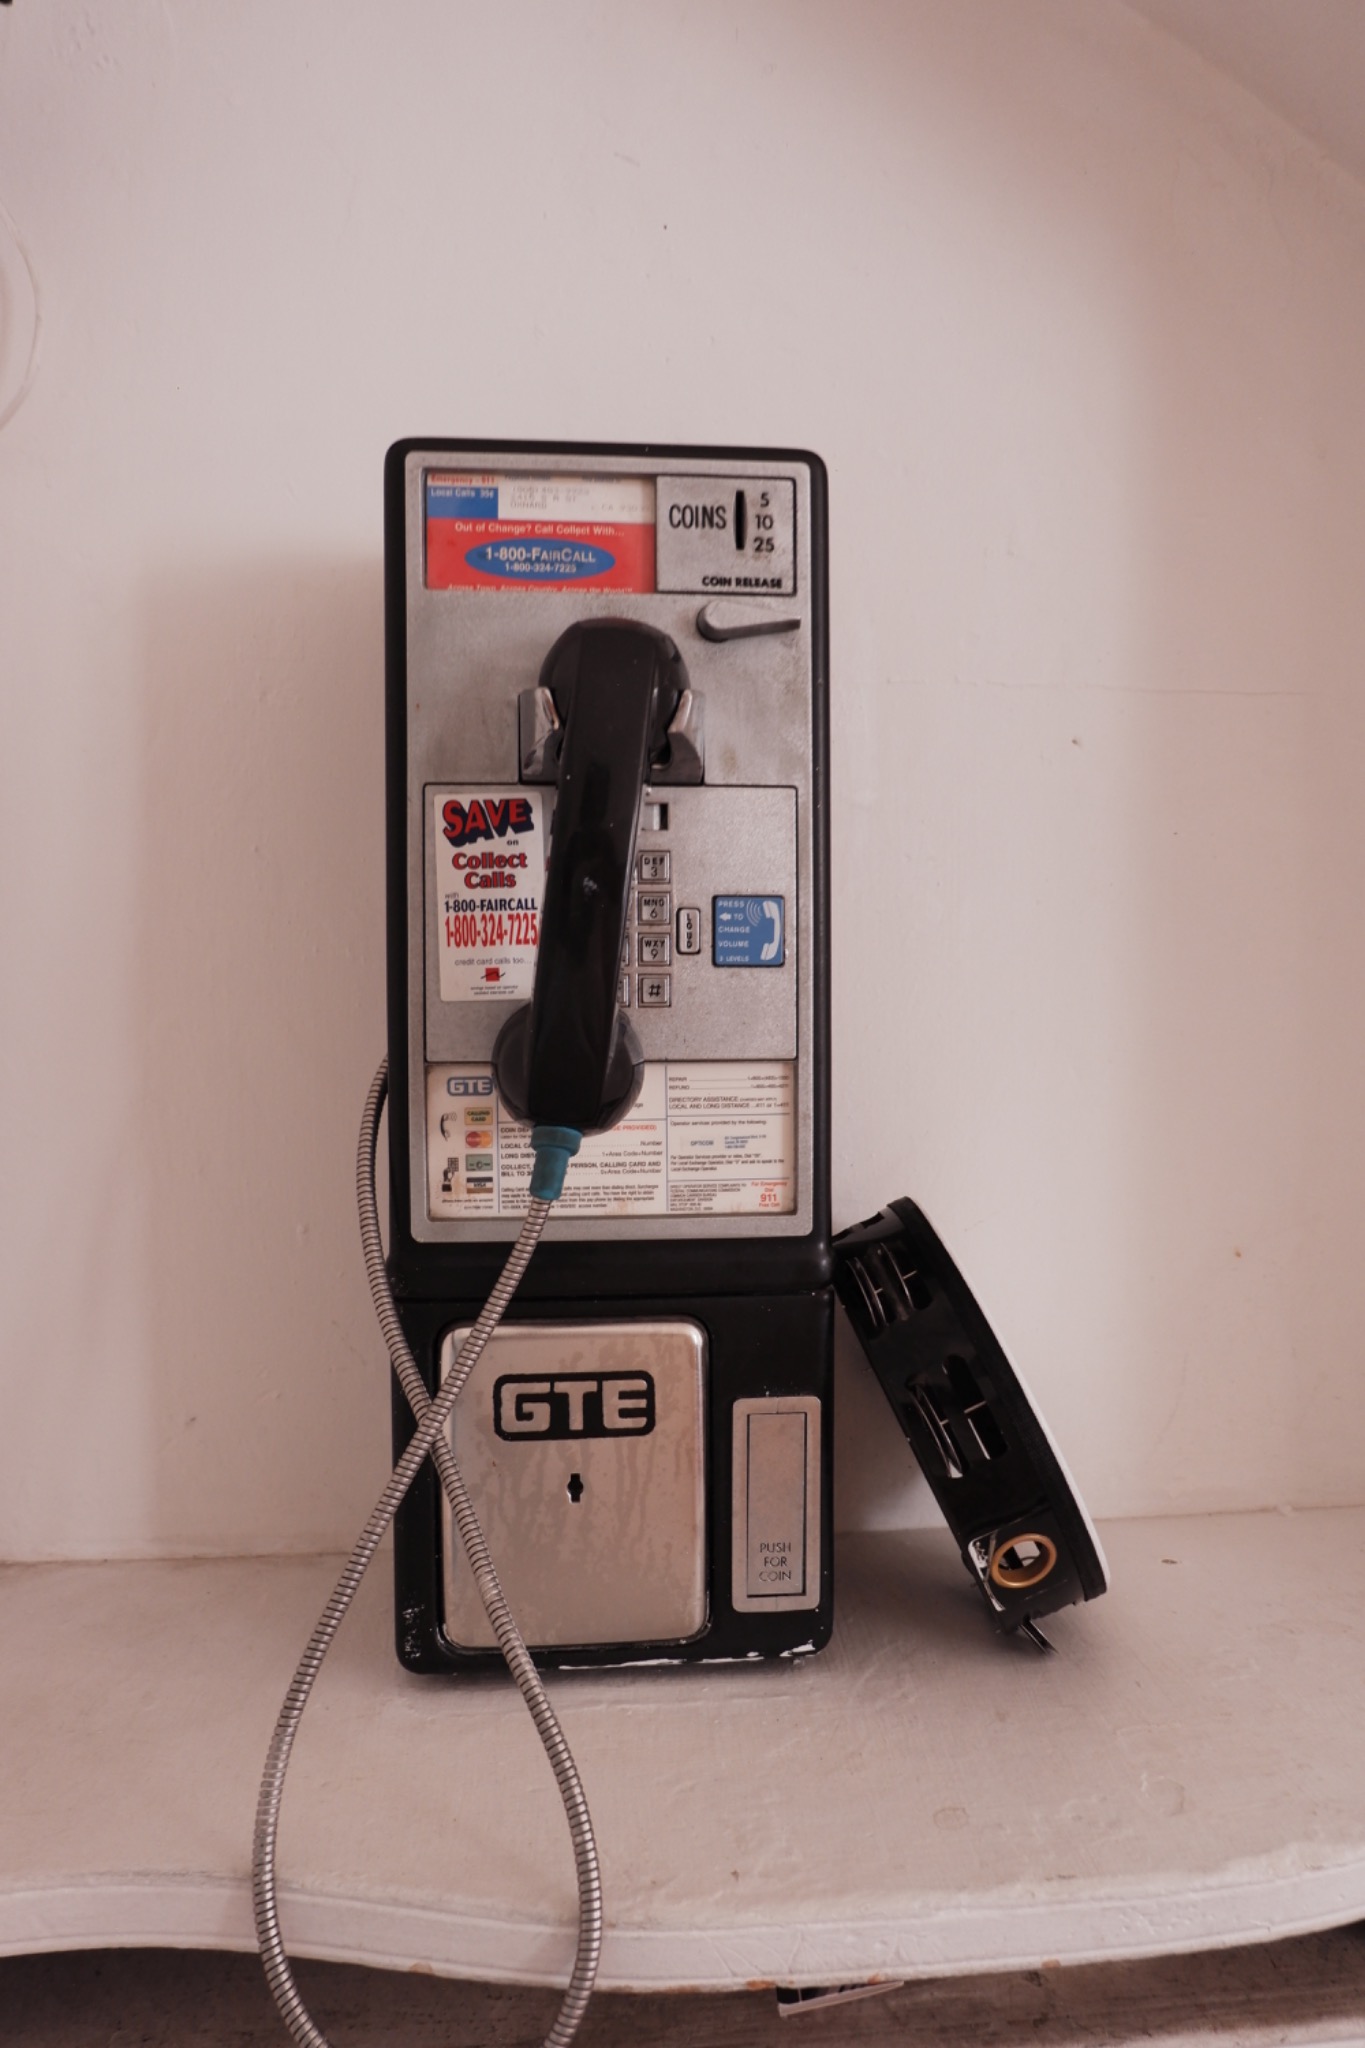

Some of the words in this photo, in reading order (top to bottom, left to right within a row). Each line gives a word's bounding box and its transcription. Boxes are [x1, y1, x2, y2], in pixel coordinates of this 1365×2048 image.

[431, 488, 453, 497] Local
[455, 488, 476, 498] Calls
[760, 492, 770, 508] 5
[669, 504, 726, 529] COINS
[755, 514, 774, 530] 10
[455, 521, 473, 532] Out
[476, 522, 486, 532] of
[488, 522, 531, 535] Change?
[535, 523, 553, 534] Call
[556, 524, 591, 535] Collect
[753, 538, 775, 553] 25
[702, 575, 732, 587] COIN
[735, 577, 782, 589] RELEASE
[443, 798, 534, 847] SAVE
[452, 852, 528, 871] Collect
[644, 857, 665, 865] DEF
[651, 866, 658, 877] 3
[464, 871, 517, 890] Calls
[444, 898, 538, 913] 1-800-FAIRCALL
[643, 898, 664, 907] MNO
[718, 900, 745, 908] PRESS
[650, 907, 657, 919] 6
[445, 912, 538, 948] 1-800-324-7225
[644, 939, 665, 948] WXY
[718, 940, 749, 948] VOLUME
[651, 949, 658, 960] 9
[454, 957, 475, 966] credit
[476, 957, 493, 965] card
[494, 956, 511, 965] calls
[449, 1078, 491, 1095] GTE
[760, 1193, 777, 1202] 911
[500, 1378, 648, 1433] GTE
[760, 1542, 792, 1553] PUSH
[764, 1556, 787, 1567] FOR
[759, 1570, 792, 1582] COIN
